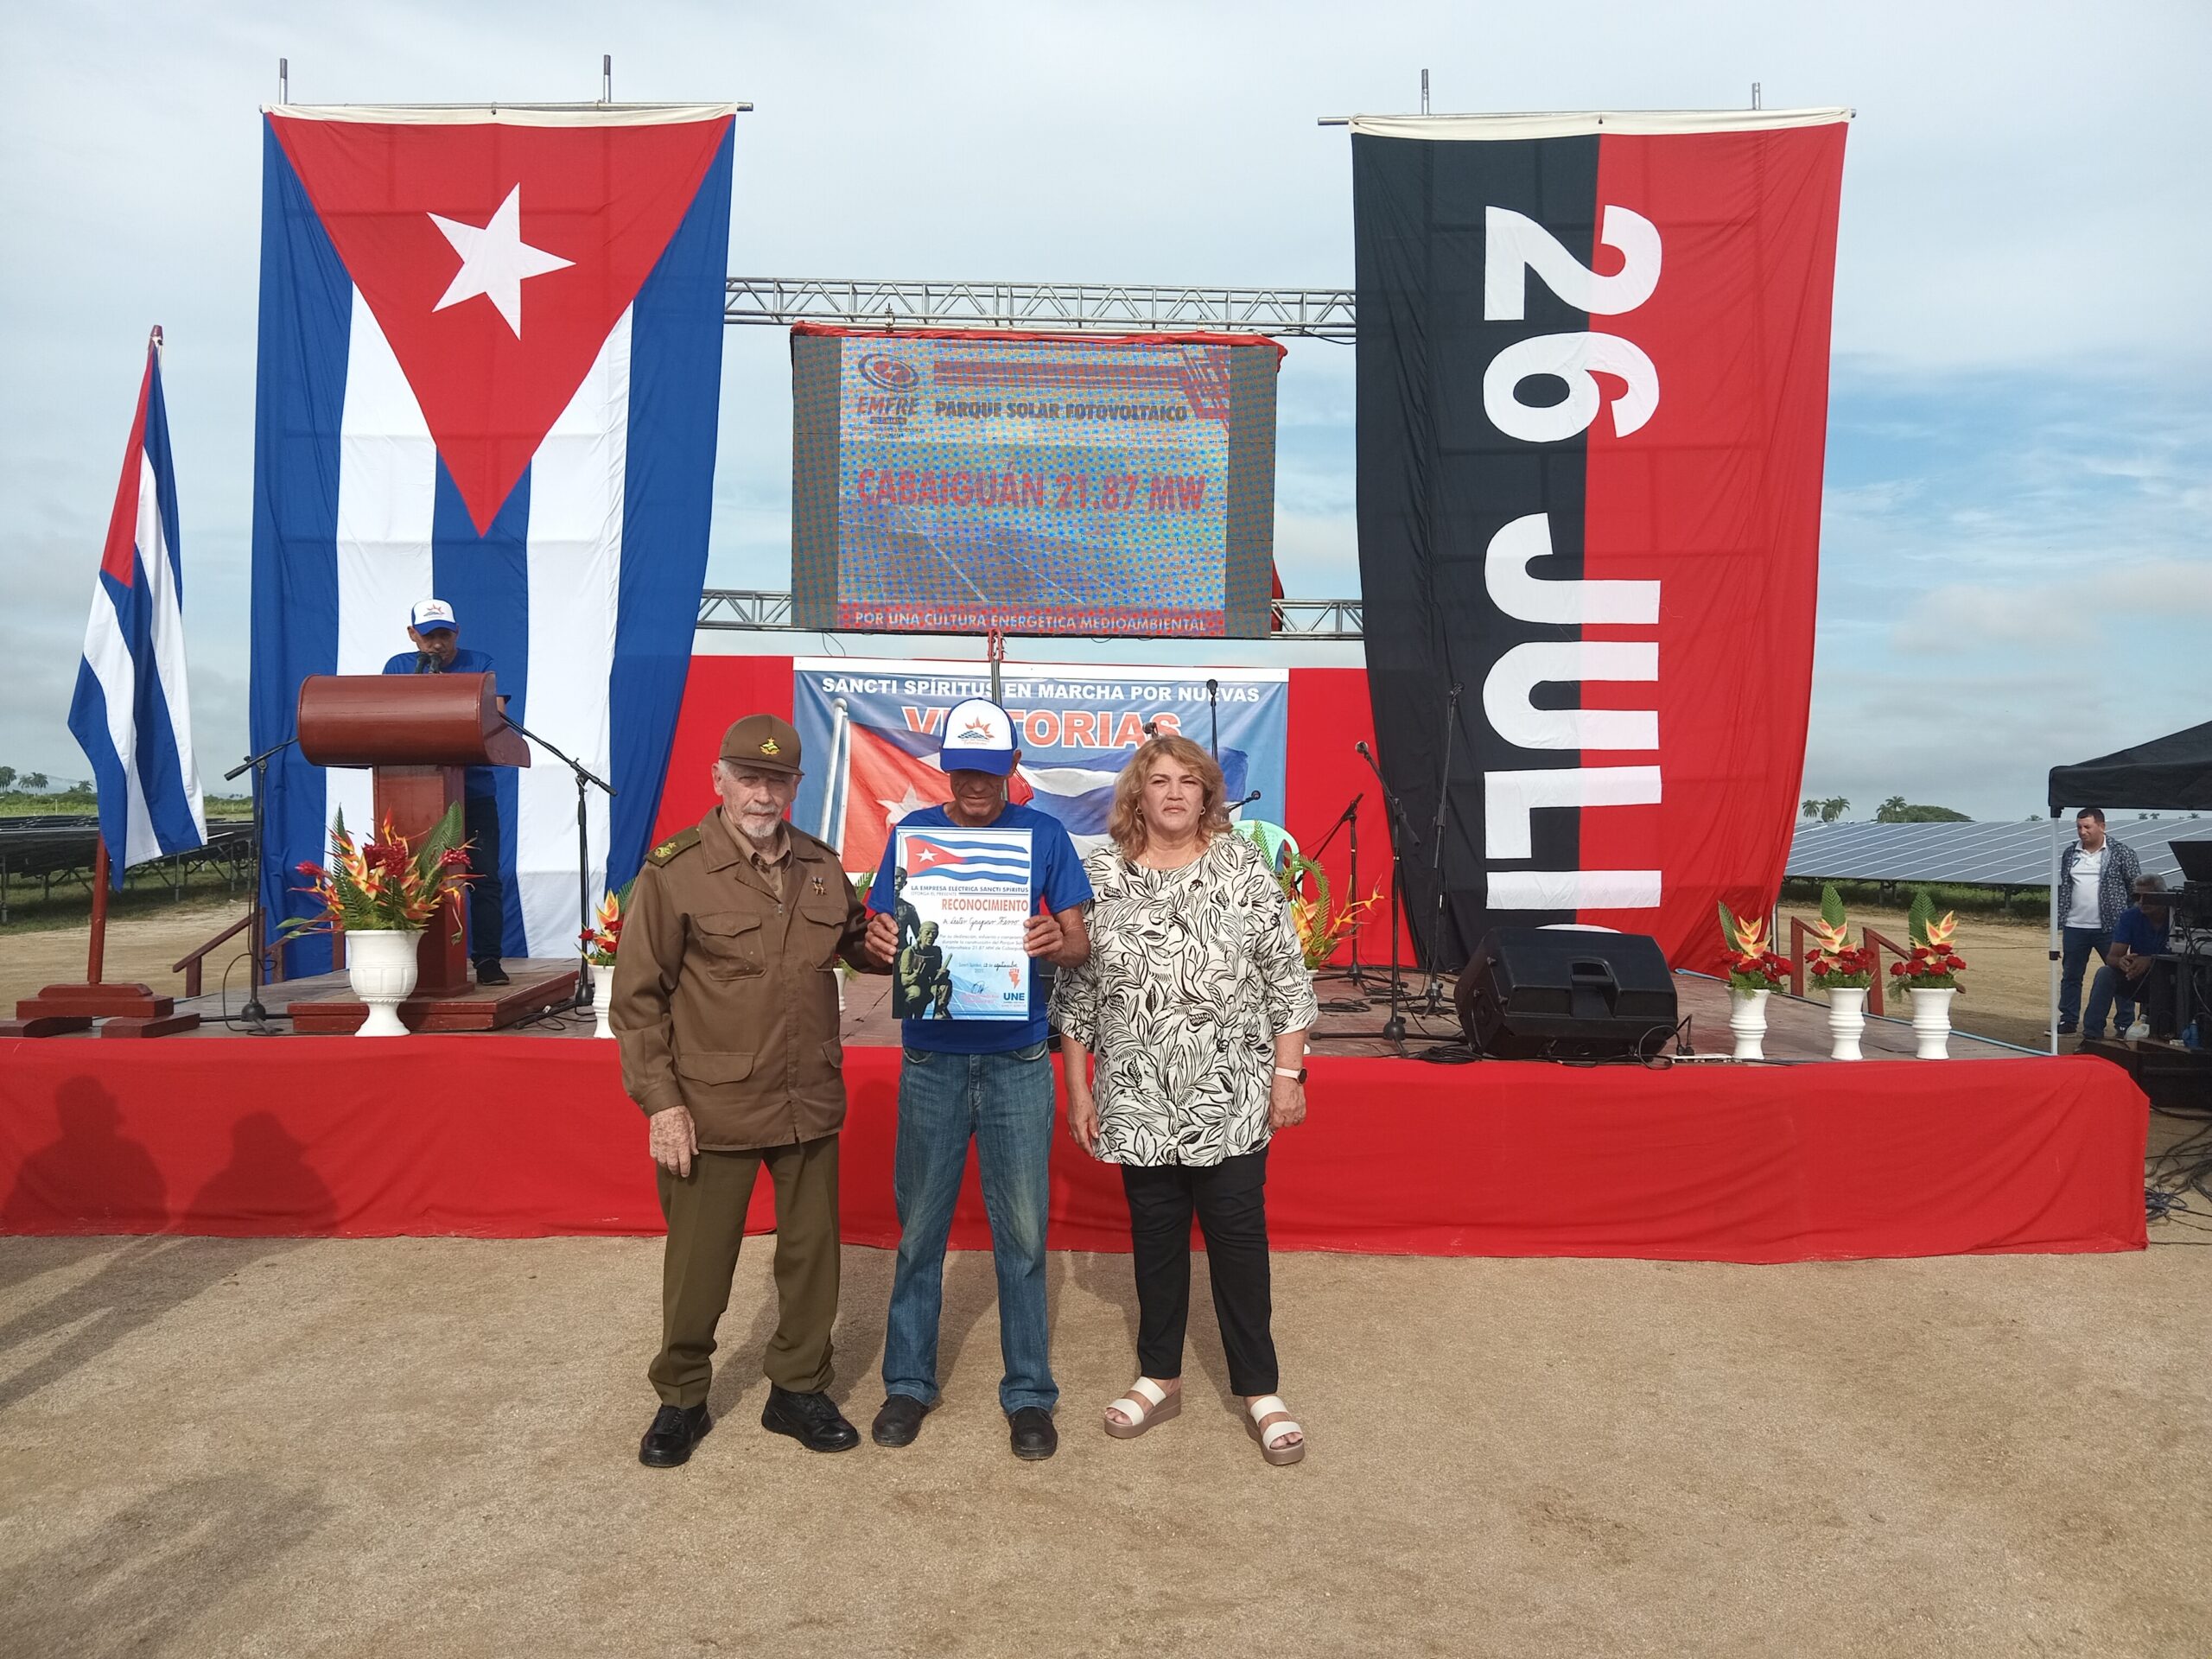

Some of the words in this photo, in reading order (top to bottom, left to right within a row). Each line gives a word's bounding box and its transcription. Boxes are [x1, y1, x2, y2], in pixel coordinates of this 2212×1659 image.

[1484, 205, 1662, 443] 26
[935, 401, 1002, 420] PARQUE
[1007, 402, 1061, 419] SOLAR
[857, 461, 1045, 508] CABAIGUÁN
[1055, 473, 1139, 511] 21.87
[1148, 474, 1207, 512] MW
[855, 611, 884, 625] POR
[888, 612, 920, 626] UNA
[924, 613, 987, 626] CULTURA
[1080, 615, 1206, 632] MEDIOAMBIENTAL
[822, 677, 898, 695] SANCTI
[1004, 683, 1032, 698] EN
[1037, 683, 1125, 700] MARCHA
[1130, 686, 1173, 702] POR
[1483, 512, 1662, 933] JULI
[942, 899, 1029, 912] RECONOCIMIENTO
